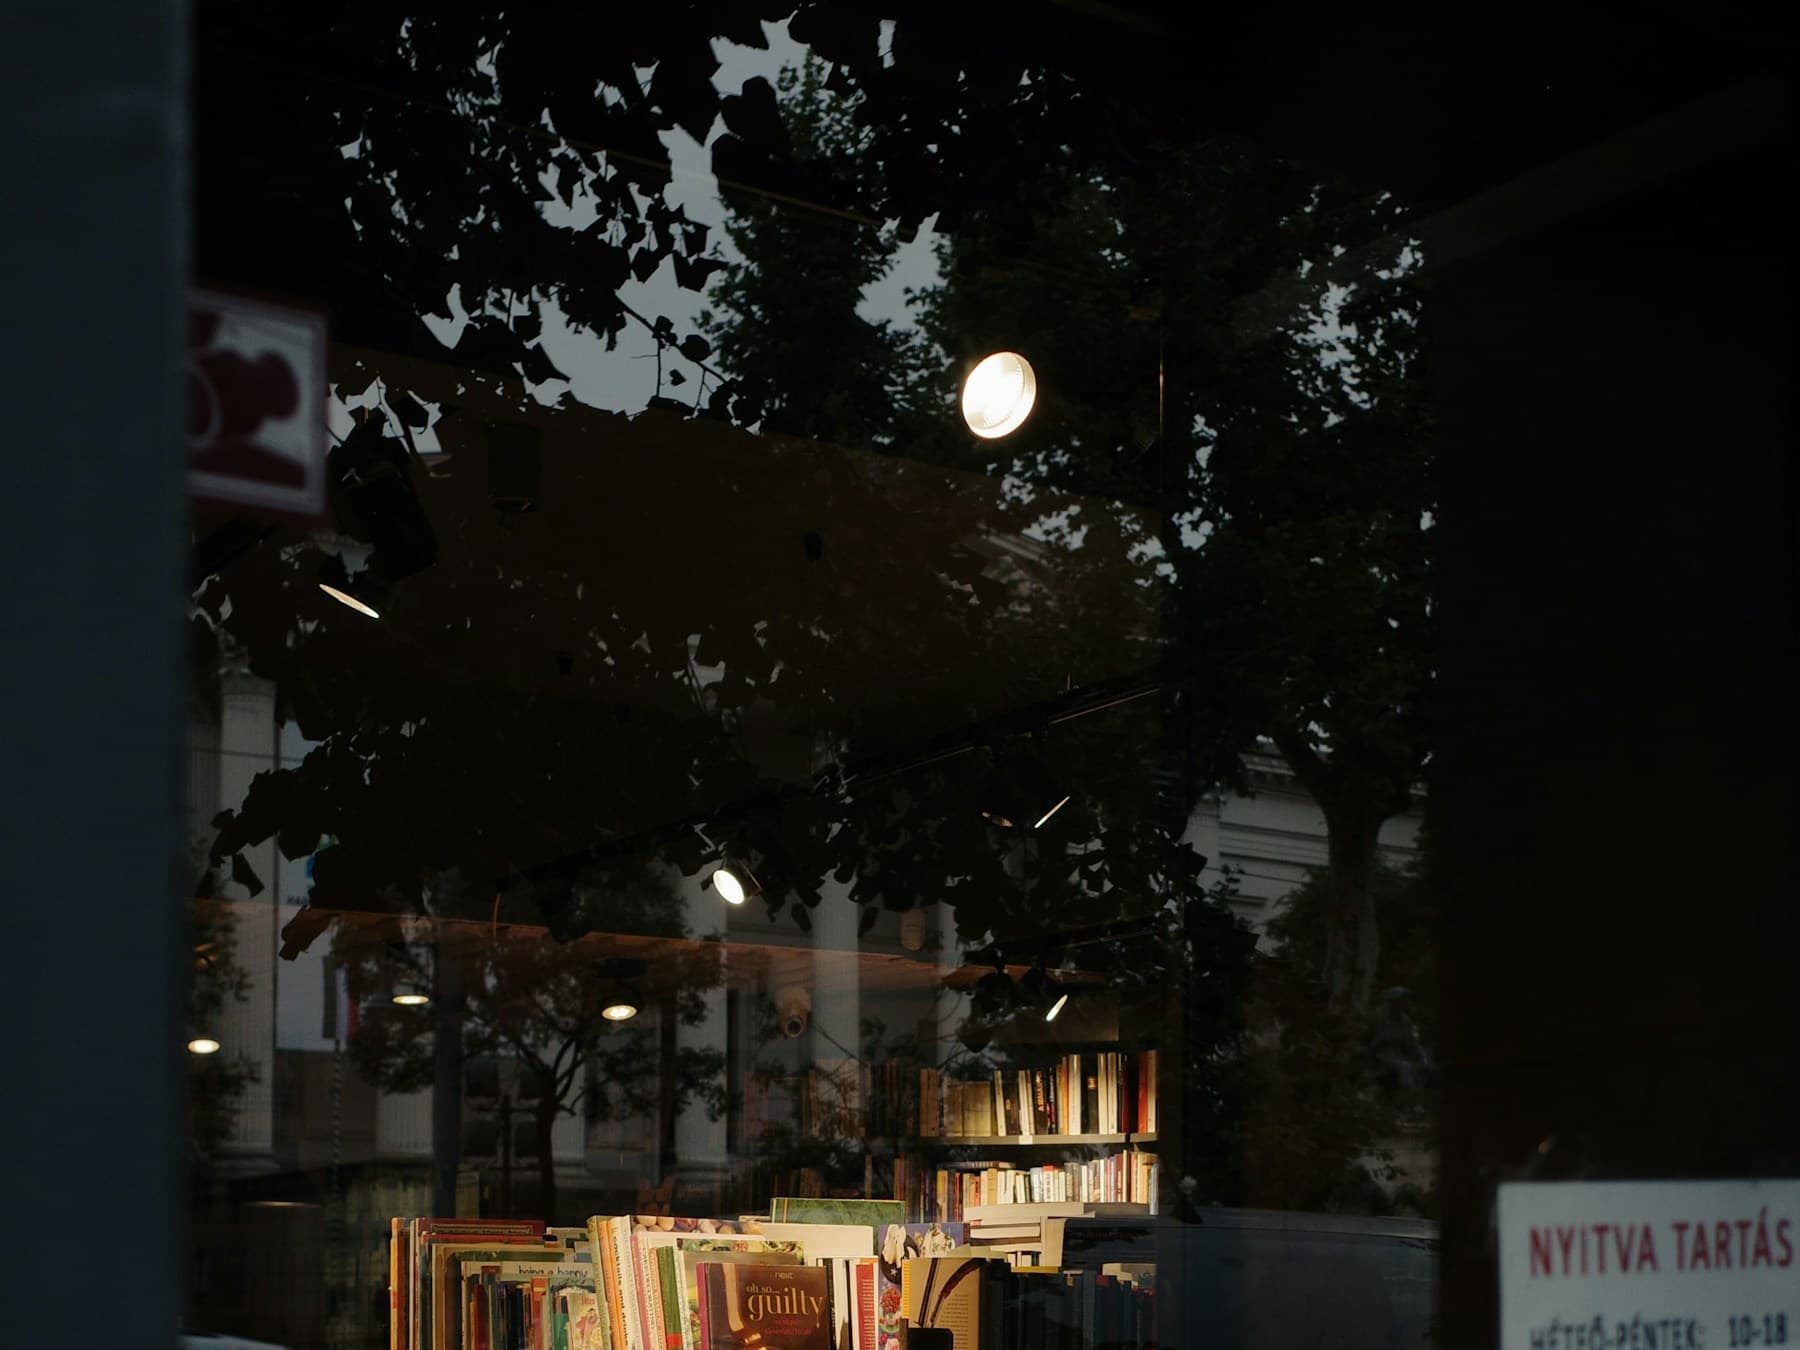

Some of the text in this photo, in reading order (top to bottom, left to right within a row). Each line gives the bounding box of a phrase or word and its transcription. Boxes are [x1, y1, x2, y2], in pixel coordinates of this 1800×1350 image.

[1530, 1206, 1793, 1277] NYITVA TARTÁS
[613, 1236, 623, 1286] cocktails
[620, 1313, 629, 1346] drinks
[746, 1283, 759, 1293] oh
[748, 1288, 823, 1325] guilty
[1728, 1312, 1788, 1348] 10-18
